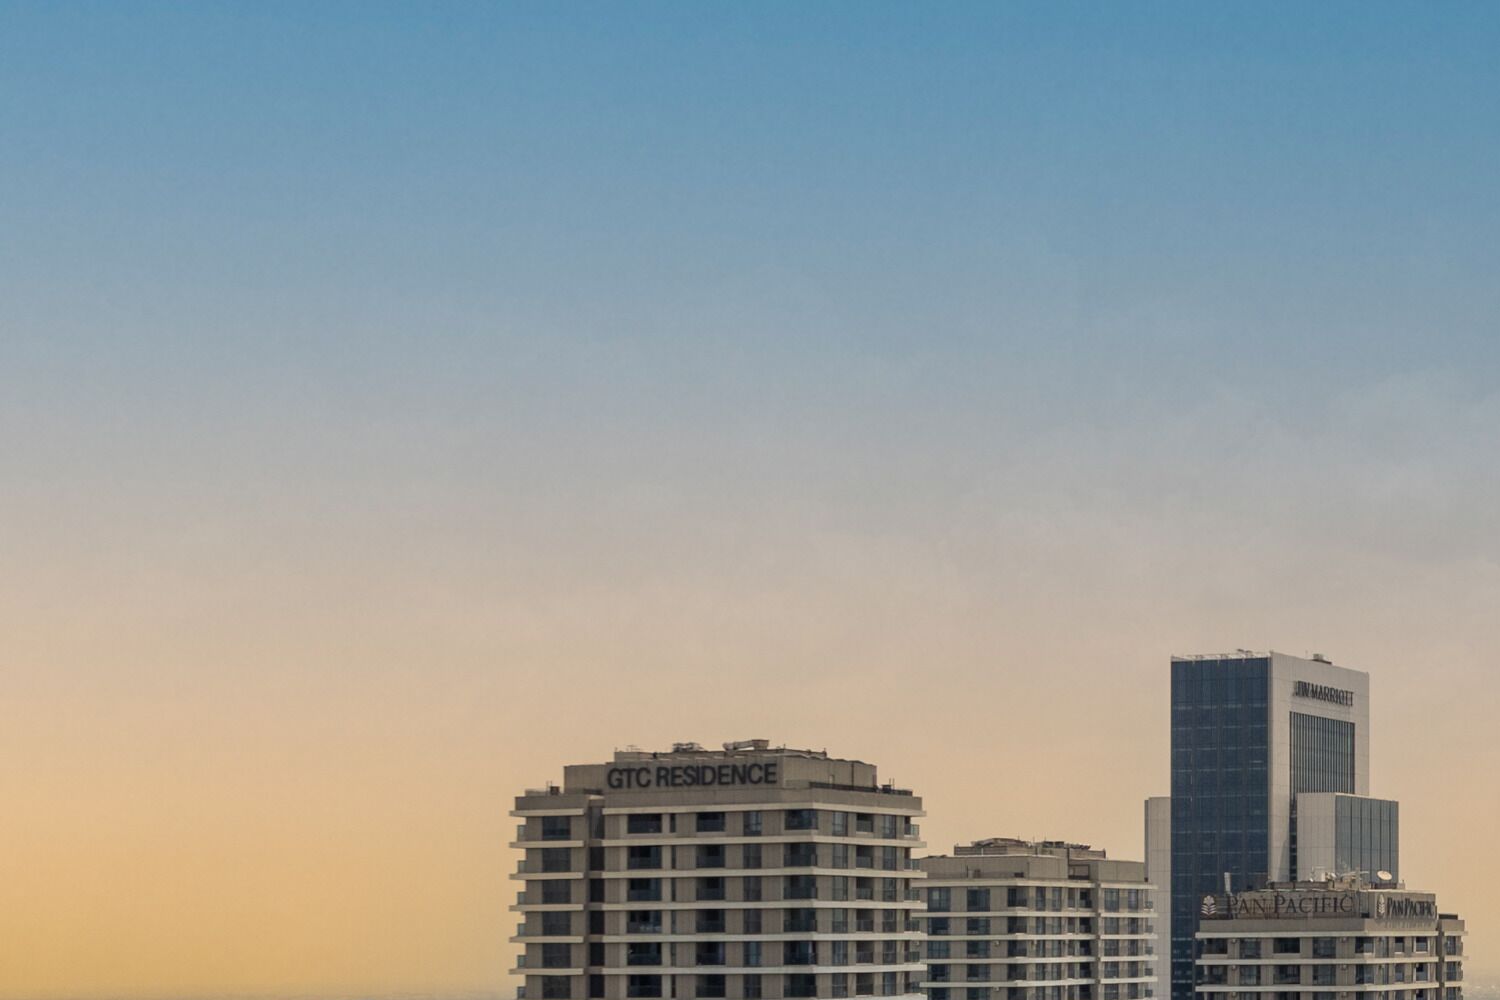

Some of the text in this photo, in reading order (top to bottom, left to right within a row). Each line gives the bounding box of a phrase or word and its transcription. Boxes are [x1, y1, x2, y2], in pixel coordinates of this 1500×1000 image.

[1295, 680, 1354, 706] JW MARRIOTT
[607, 763, 778, 788] GTC RESIDENCE
[1226, 892, 1354, 914] PAN PACIFIC
[1387, 897, 1436, 917] PAN PACIFIC
